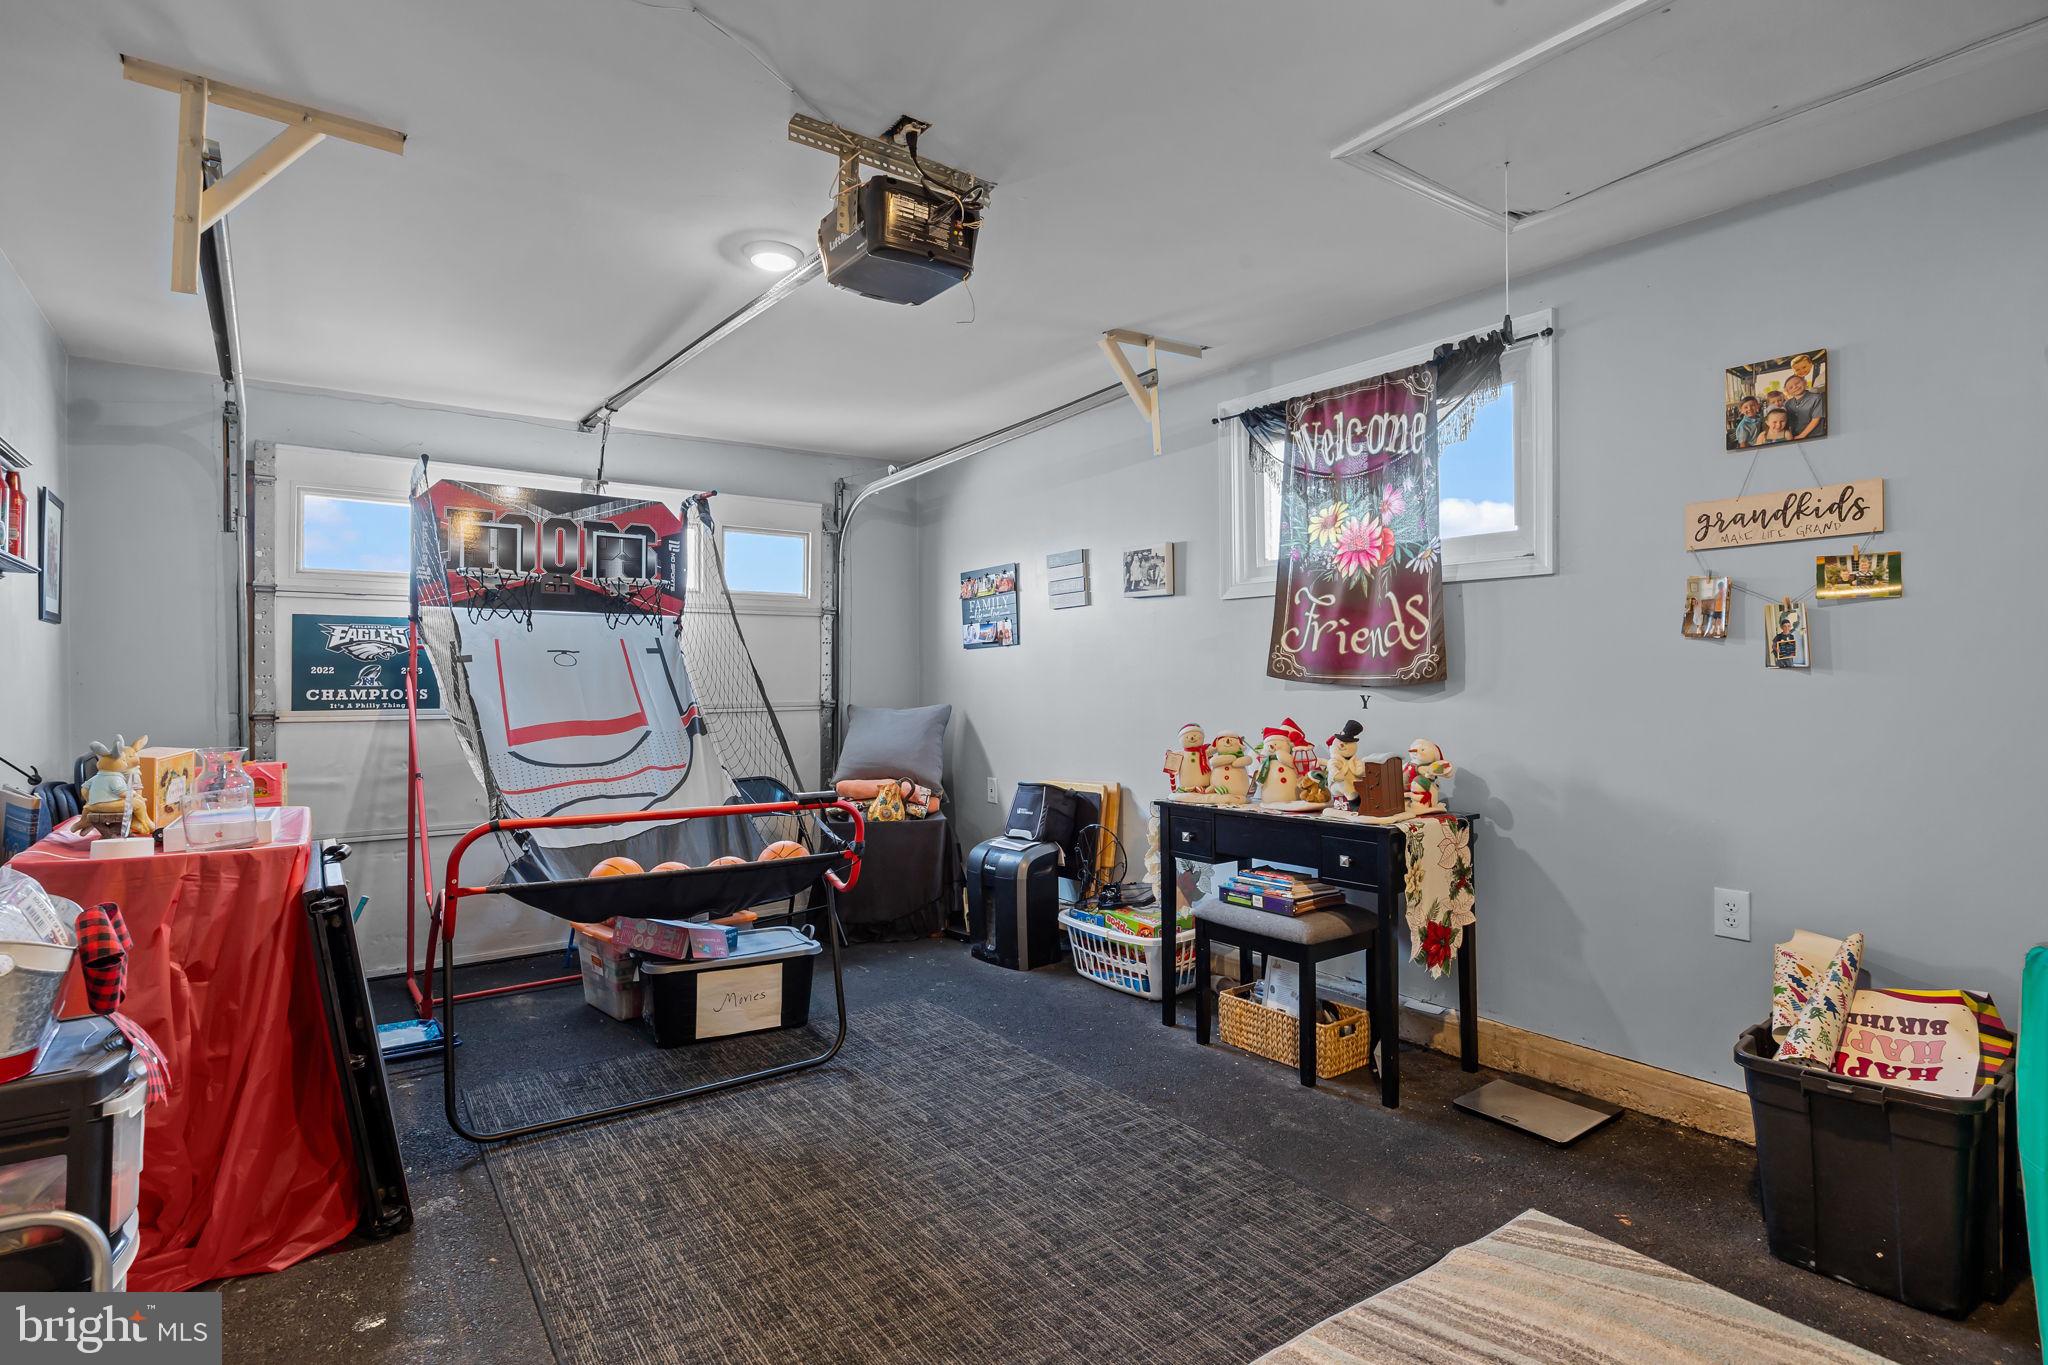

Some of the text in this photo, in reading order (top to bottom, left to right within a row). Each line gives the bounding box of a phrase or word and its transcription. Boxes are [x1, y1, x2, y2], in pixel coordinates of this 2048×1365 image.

[1290, 410, 1428, 469] Welcome
[1694, 485, 1871, 543] grandkids
[1720, 521, 1842, 545] MAKE LIFE GRAND
[968, 595, 1009, 613] FAMILY
[1280, 586, 1430, 658] Friends
[333, 626, 407, 645] EAGLES
[310, 666, 335, 675] 2022
[400, 667, 423, 675] 23
[305, 688, 428, 701] CHAMPIOS
[1359, 694, 1372, 710] Y
[355, 702, 380, 710] Philly
[382, 702, 406, 710] Thing
[712, 991, 766, 1012] Movies
[1847, 1012, 1950, 1036] BIRTHD
[1838, 1028, 1947, 1065] HAP
[1831, 1052, 1944, 1082] HAPP
